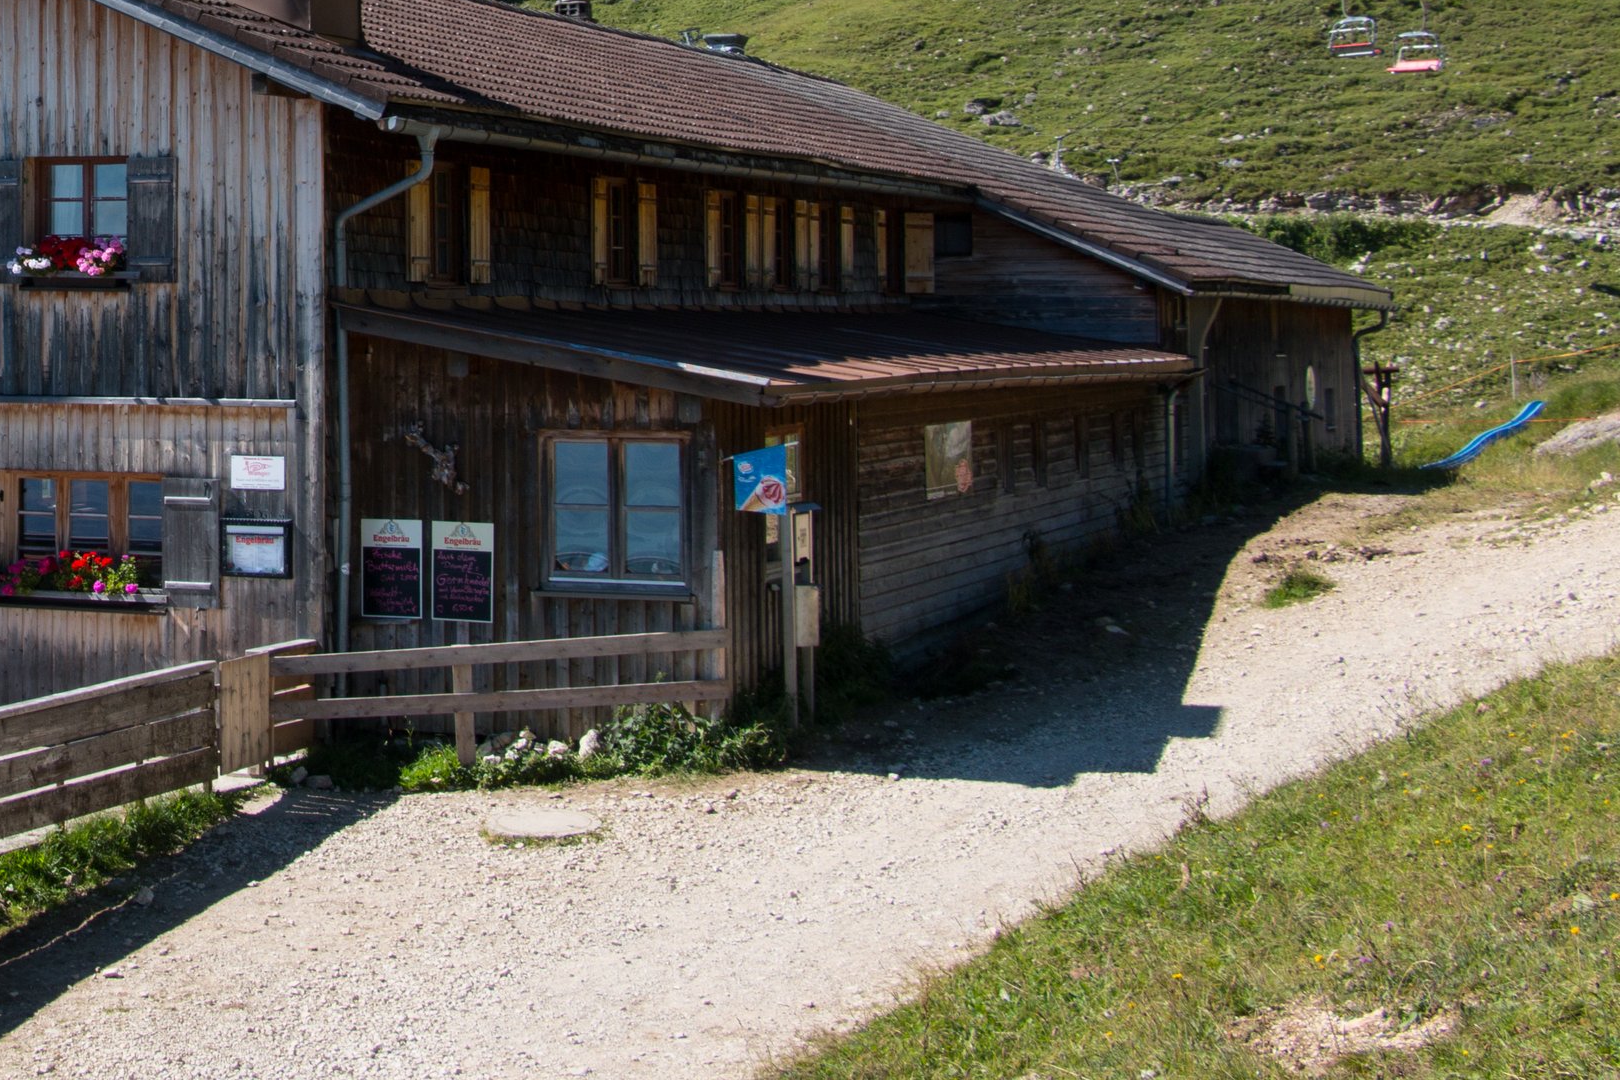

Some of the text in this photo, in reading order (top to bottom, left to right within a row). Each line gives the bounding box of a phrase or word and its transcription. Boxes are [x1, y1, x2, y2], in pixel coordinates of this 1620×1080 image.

[235, 535, 274, 545] Engelbräu
[373, 534, 410, 544] Engelbräu
[444, 536, 482, 546] Engelbräu
